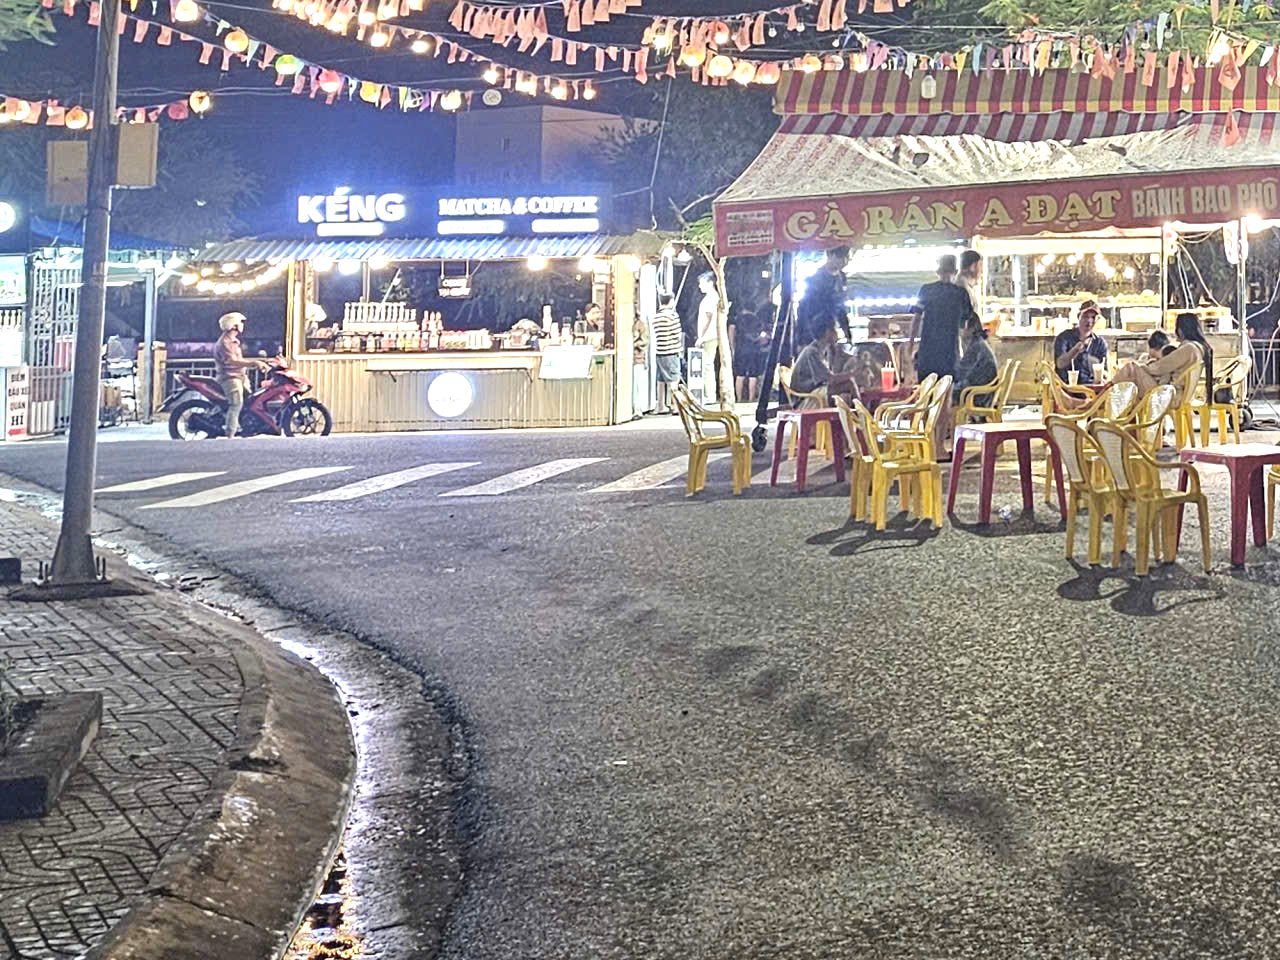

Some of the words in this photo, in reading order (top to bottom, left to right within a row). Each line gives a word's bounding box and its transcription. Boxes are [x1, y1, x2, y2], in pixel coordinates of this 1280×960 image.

[438, 198, 512, 215] MATCHA
[528, 196, 599, 214] COFFEE
[784, 201, 853, 240] GÀ
[863, 196, 965, 235] RÁN
[975, 196, 1016, 231] A
[1023, 189, 1122, 232] ĐẠT
[1131, 183, 1185, 218] BÁNH
[1191, 184, 1232, 214] BAO
[1238, 177, 1279, 210] PHÔ
